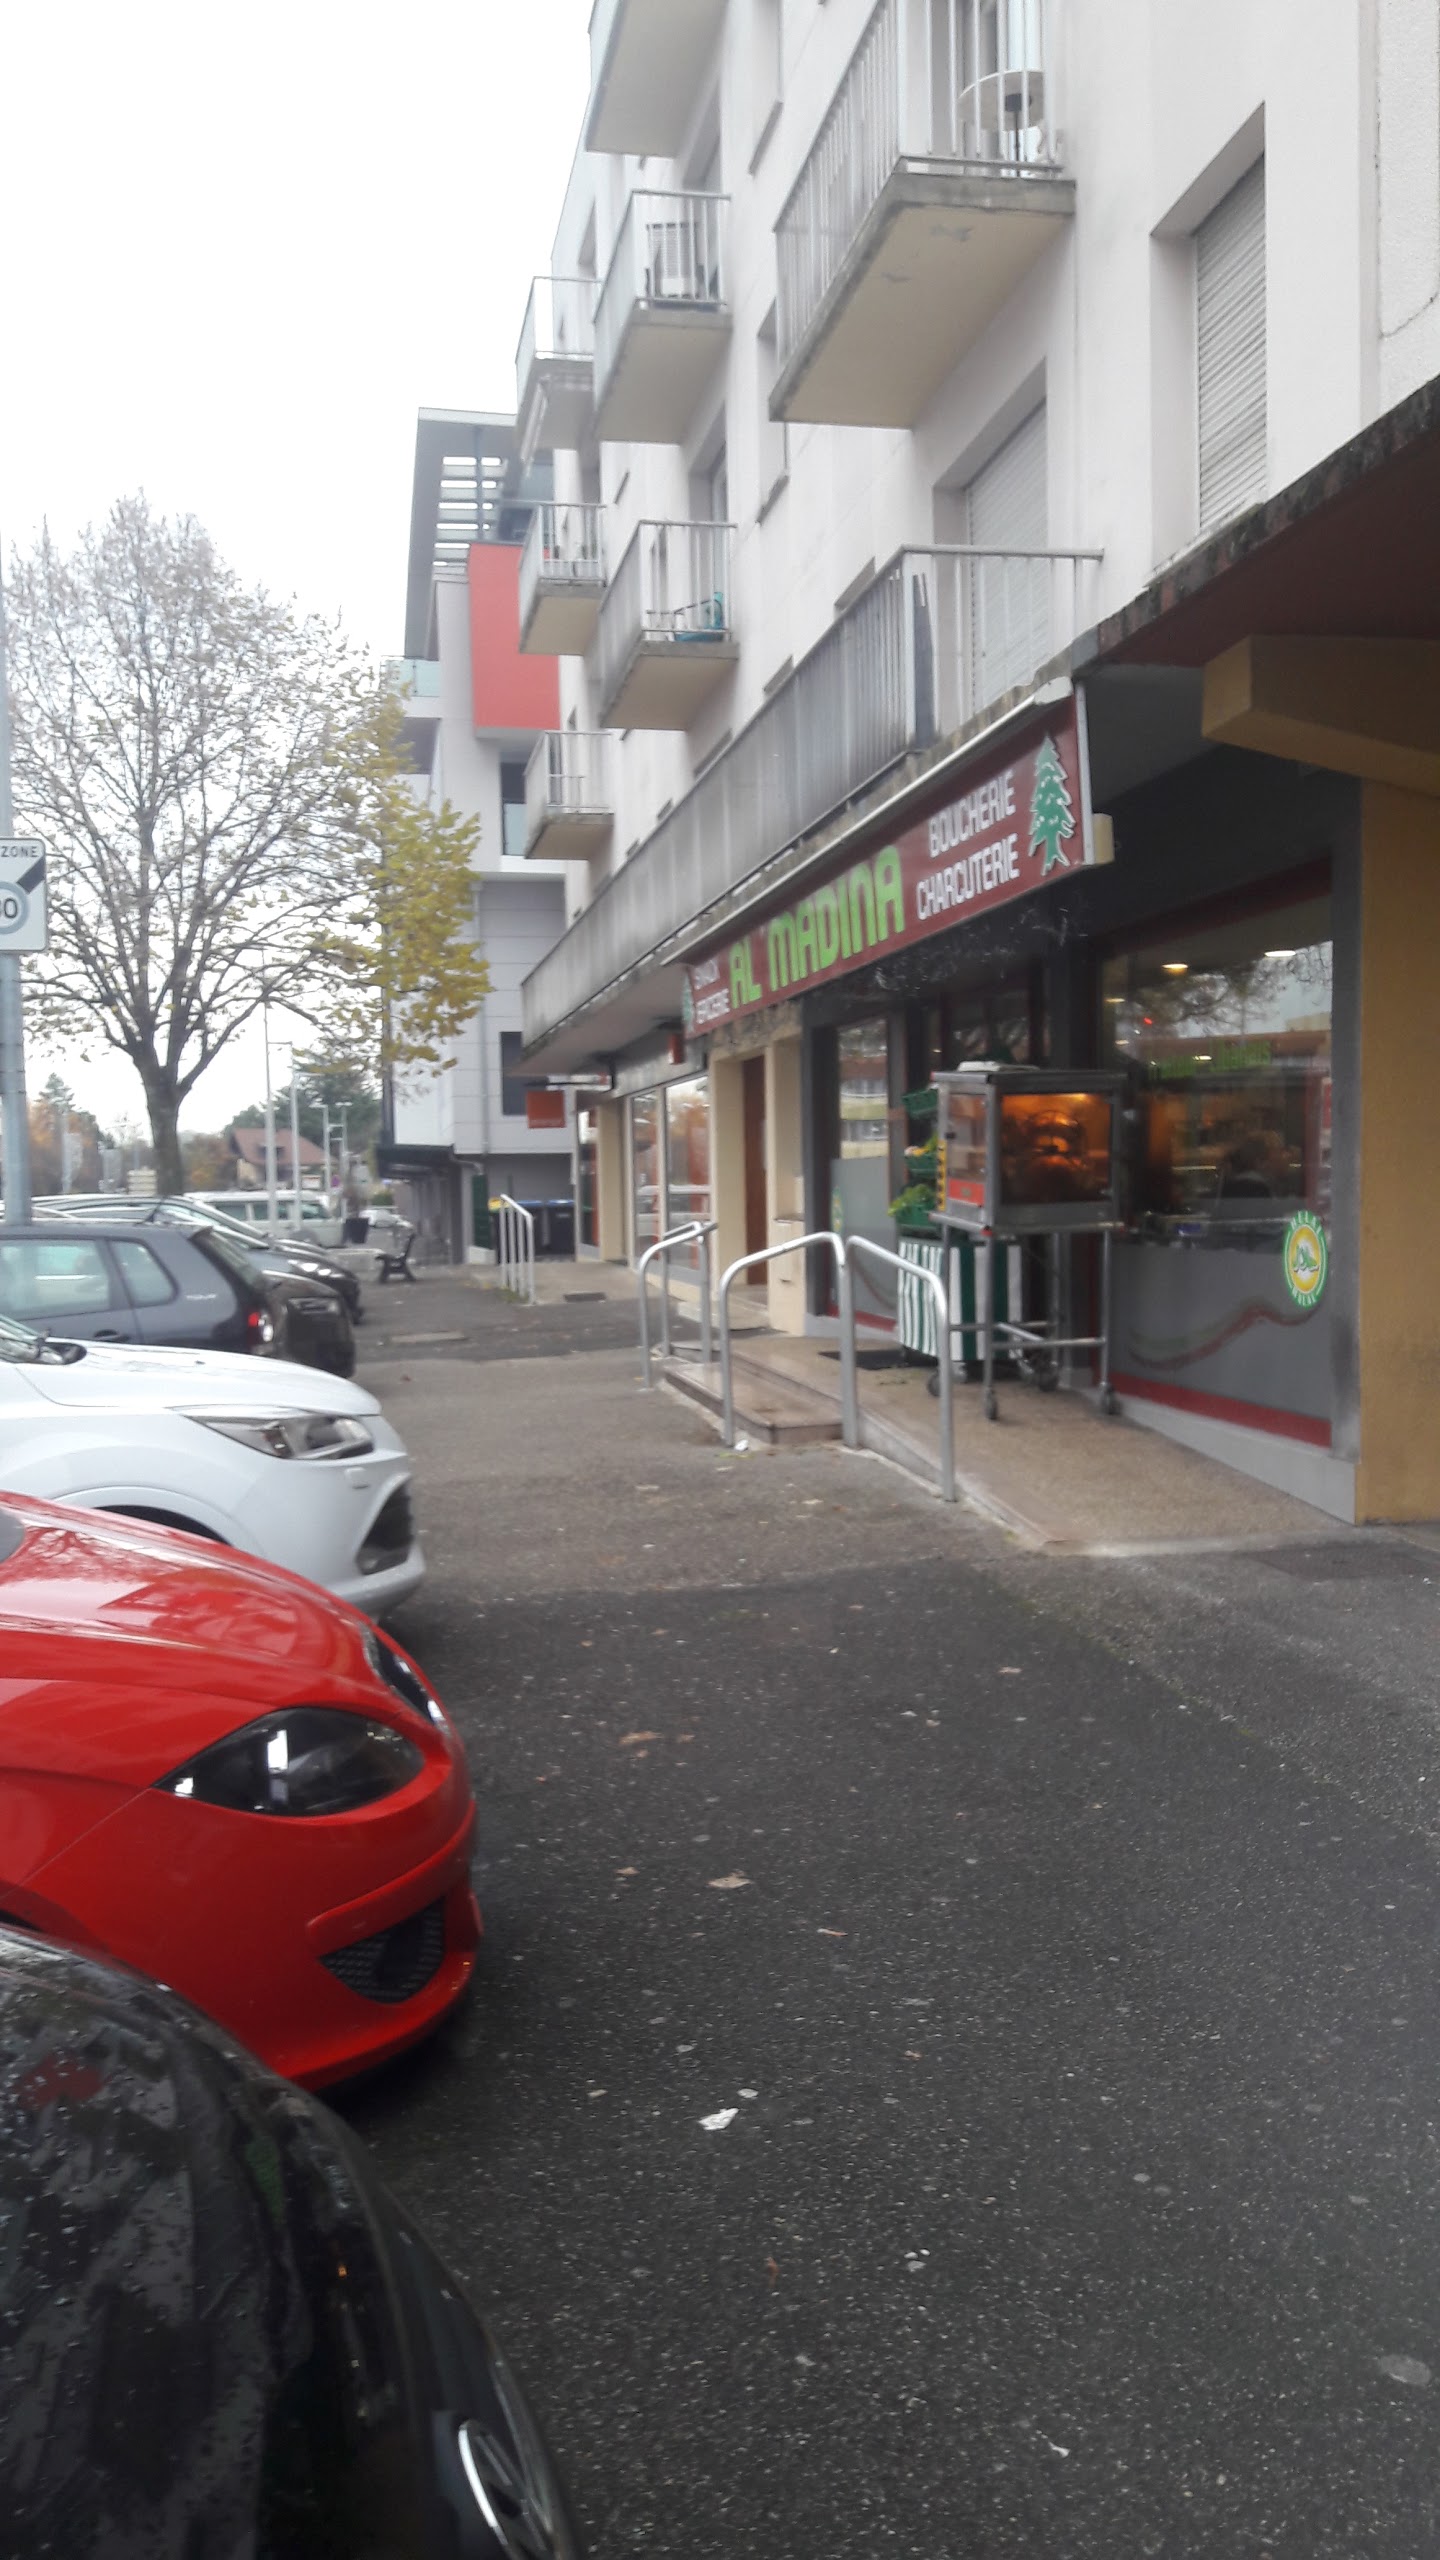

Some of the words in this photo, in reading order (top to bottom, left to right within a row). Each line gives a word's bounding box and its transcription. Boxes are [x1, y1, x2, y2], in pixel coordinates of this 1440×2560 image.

[1, 845, 39, 858] ZONE
[929, 769, 1016, 858] BOUCHERIE
[0, 898, 18, 919] 0
[917, 832, 1020, 920] CHARCUTERIE
[729, 935, 762, 1009] AL
[767, 845, 905, 992] MADINA
